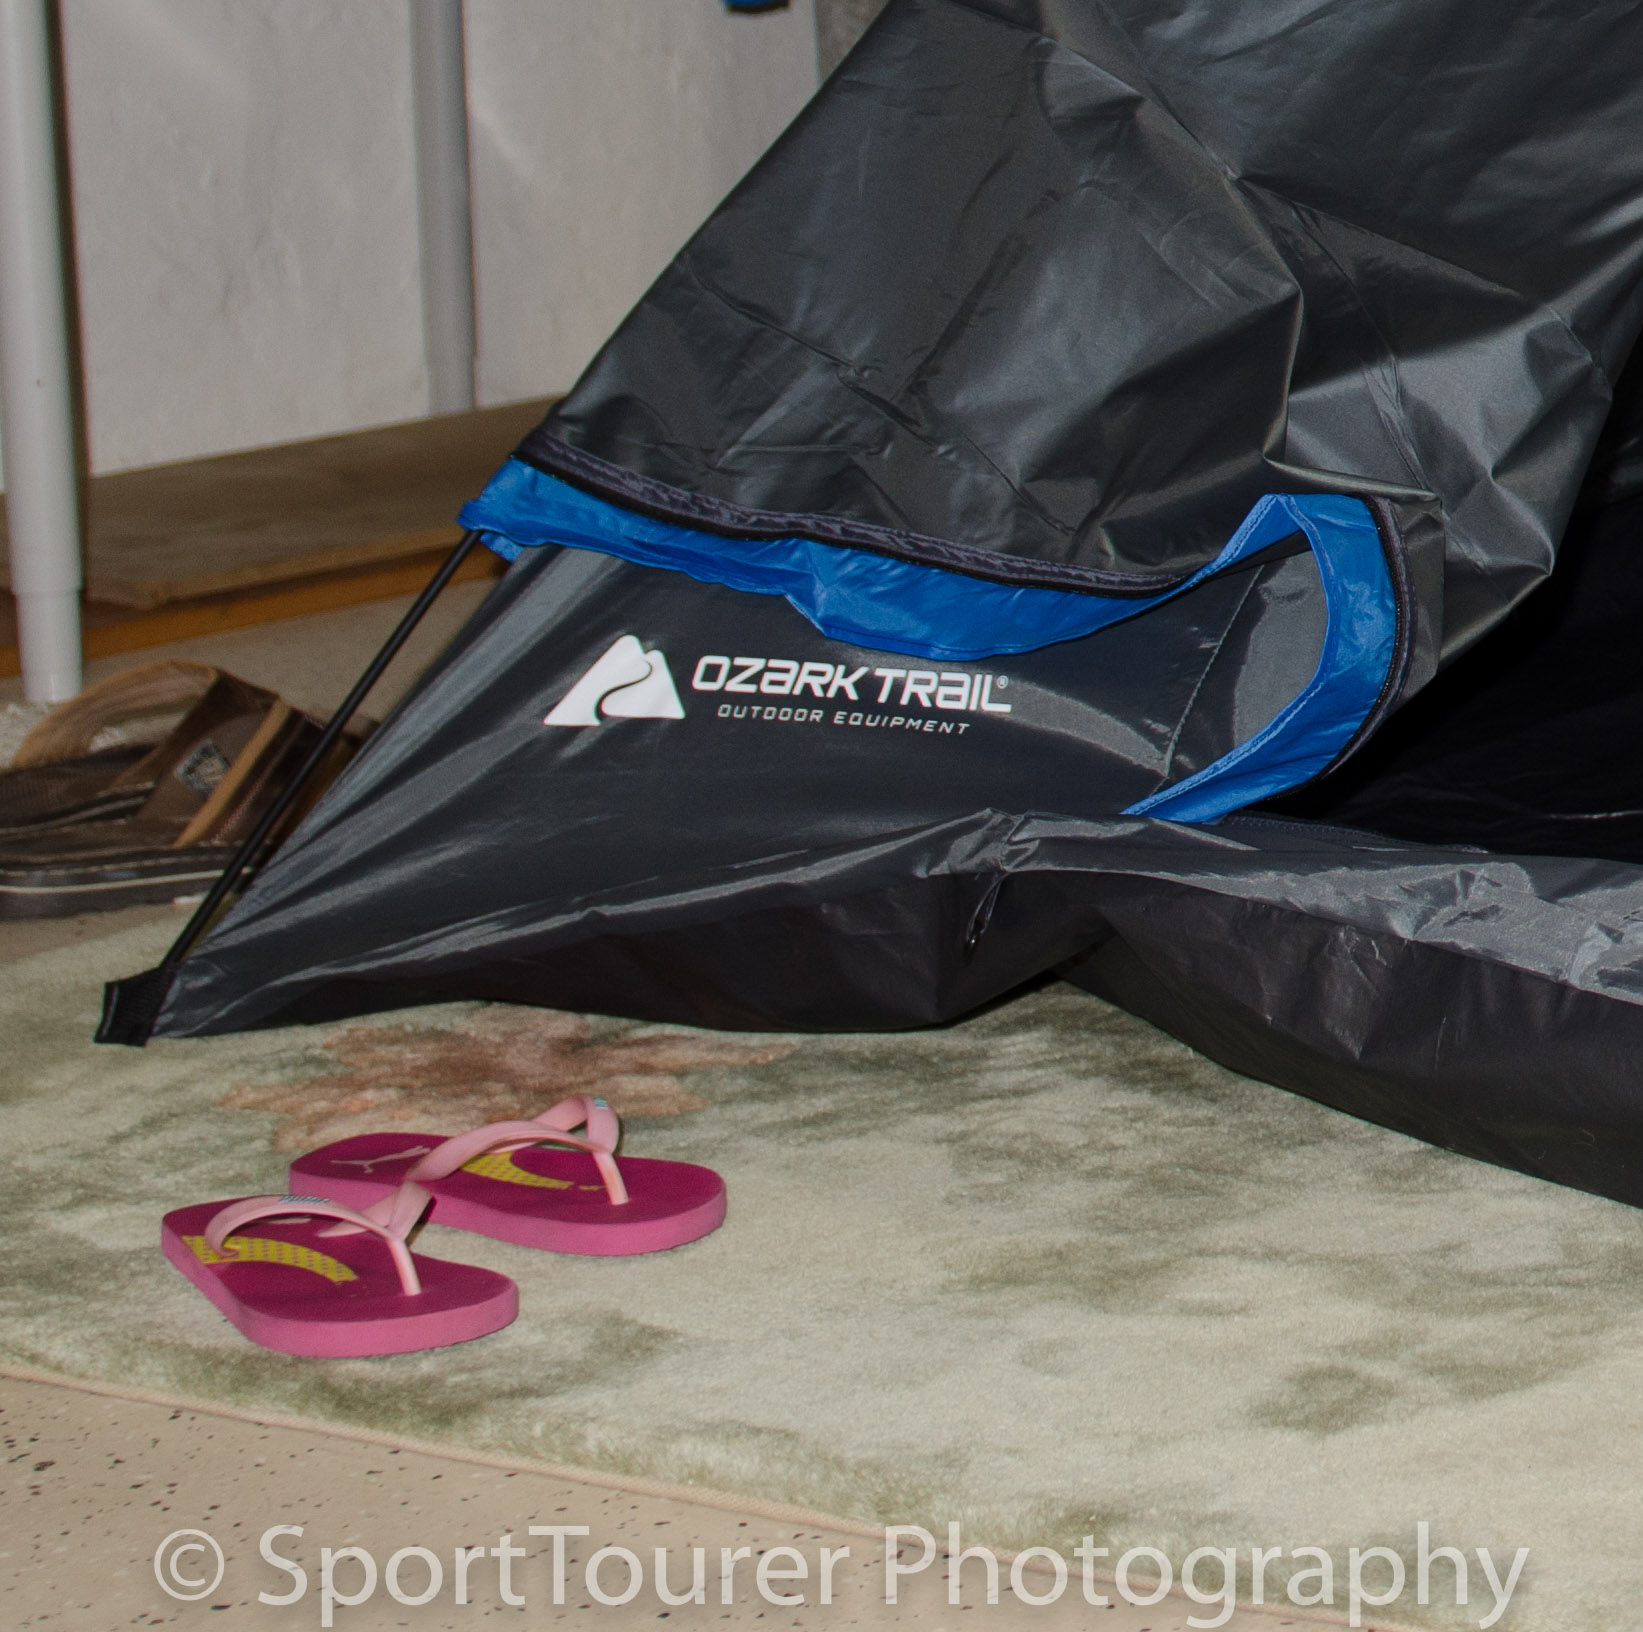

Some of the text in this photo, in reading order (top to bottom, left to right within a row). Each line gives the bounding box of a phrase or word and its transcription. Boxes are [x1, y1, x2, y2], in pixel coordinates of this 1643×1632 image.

[691, 655, 870, 701] OZARK
[717, 703, 971, 735] OUTDOOR EQUIPMENT
